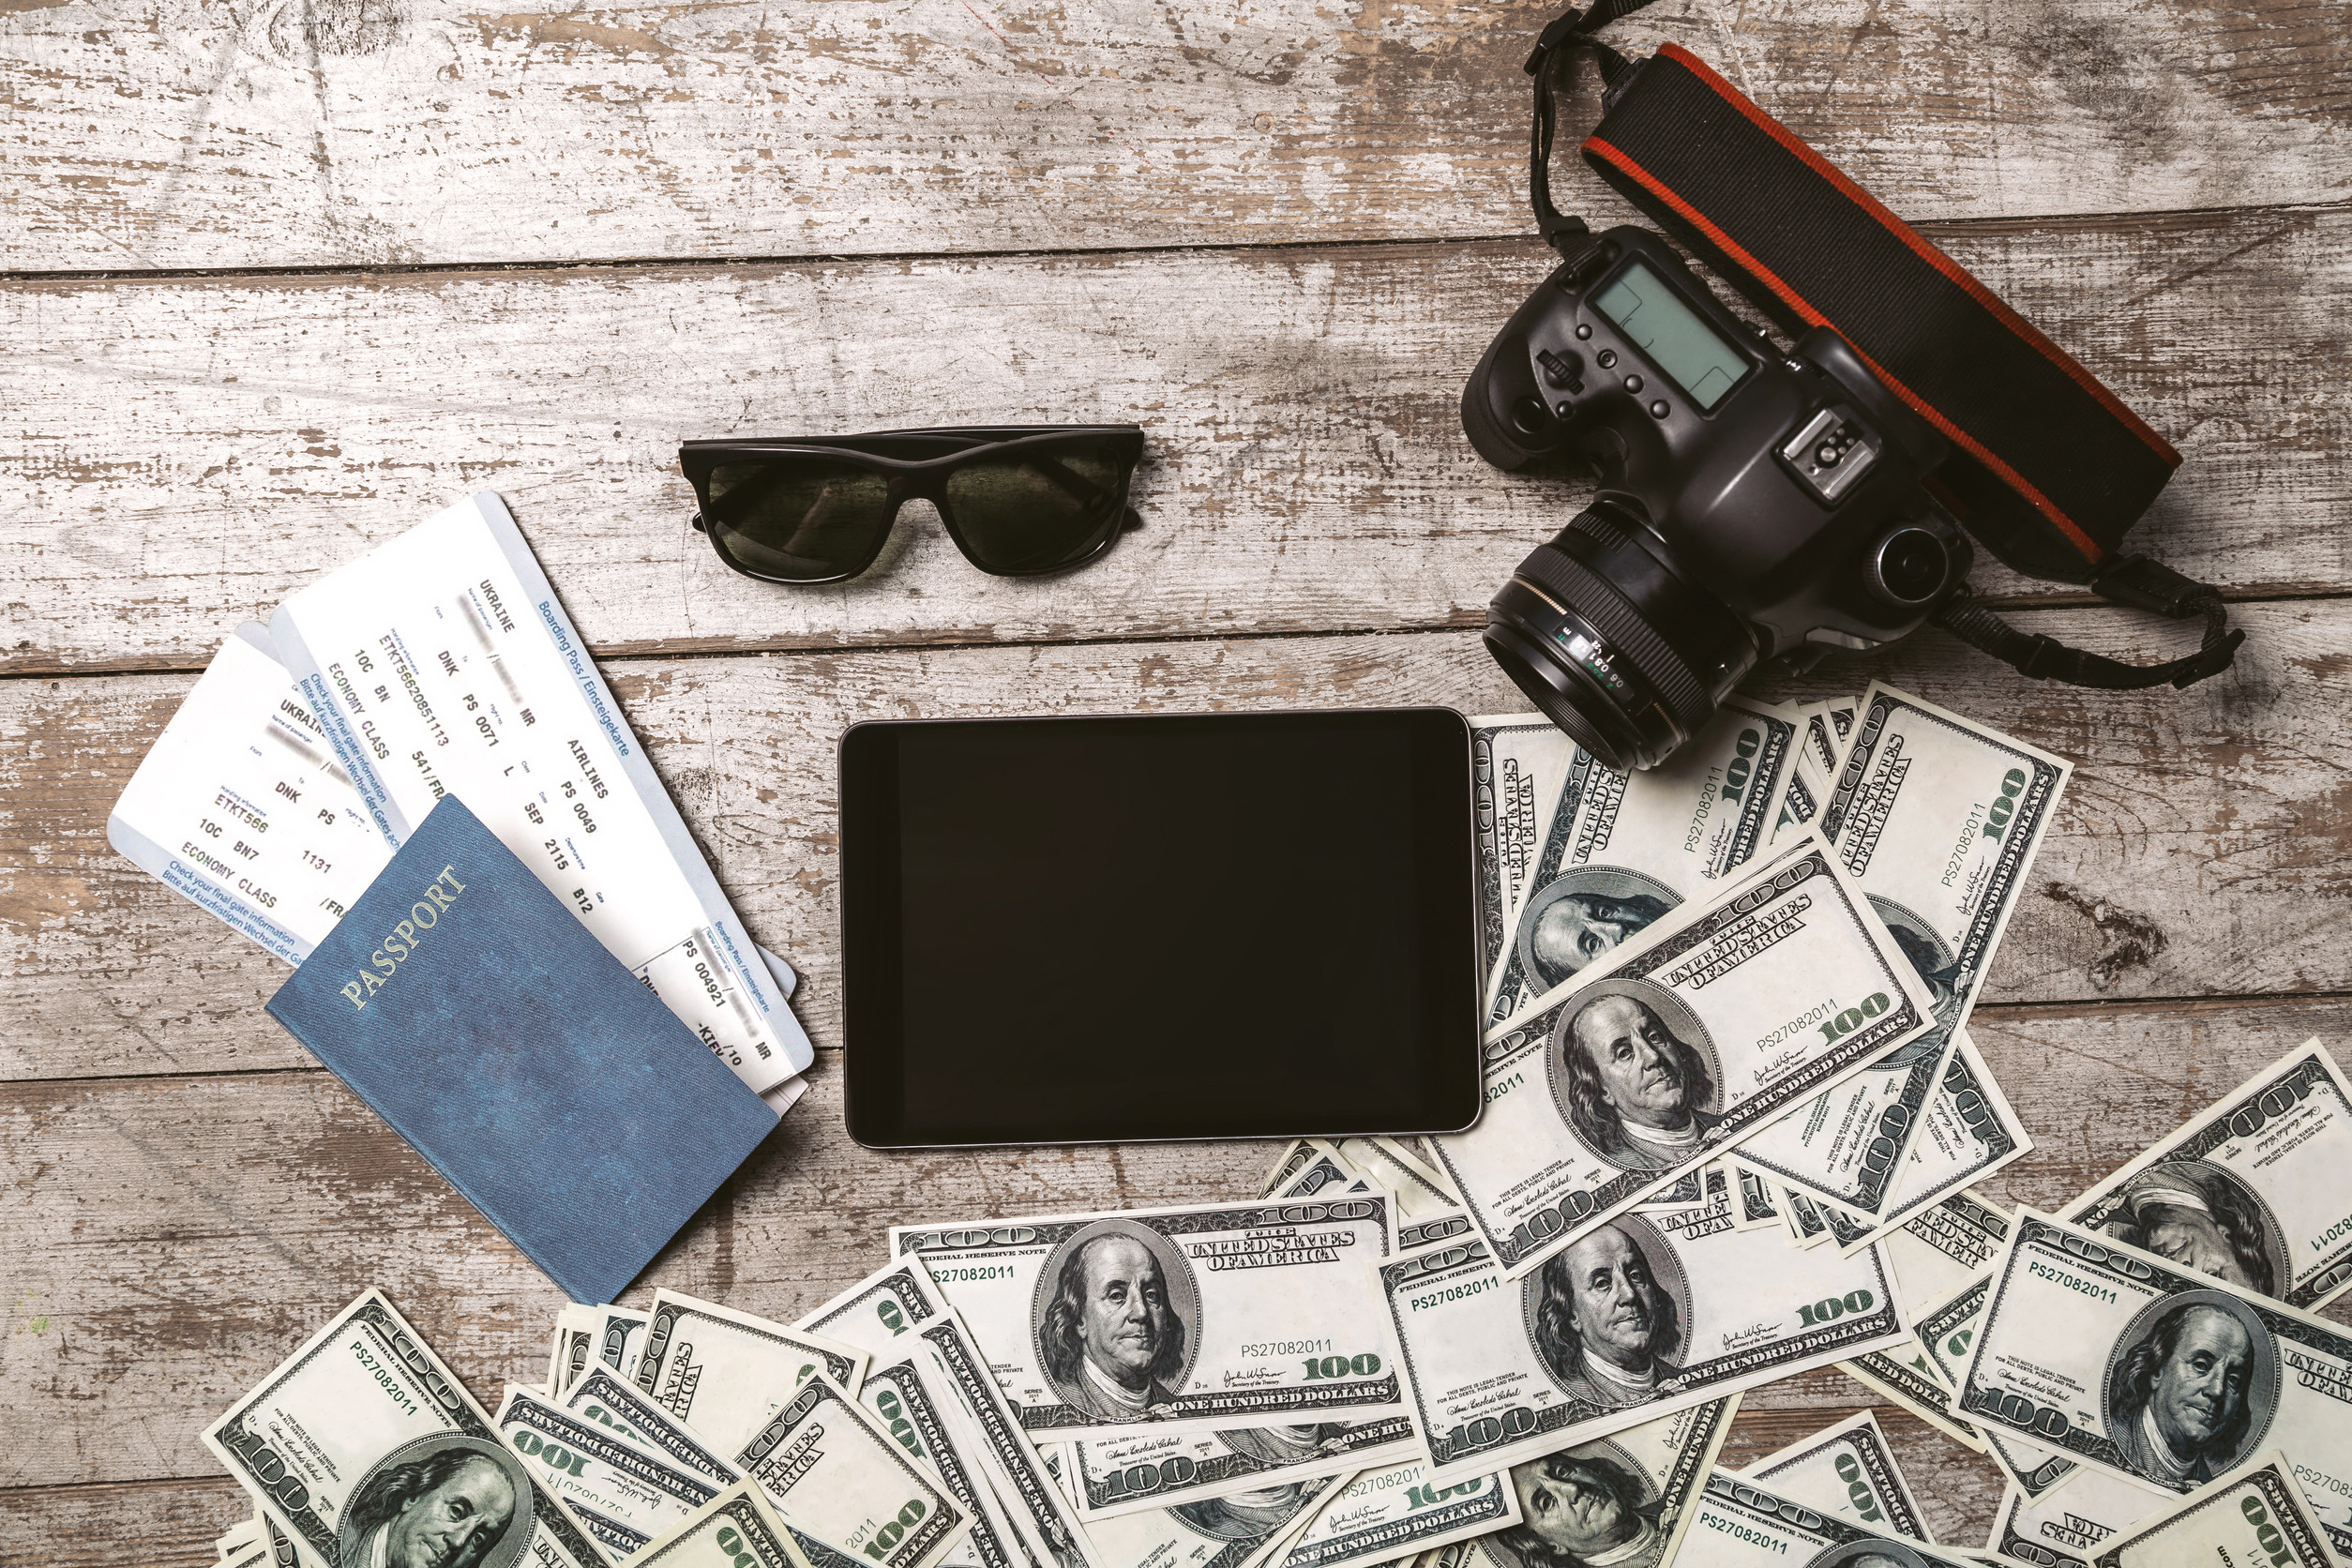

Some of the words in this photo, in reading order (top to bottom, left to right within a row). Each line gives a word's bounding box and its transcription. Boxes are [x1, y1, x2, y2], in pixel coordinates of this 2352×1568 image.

[355, 649, 373, 673] 10C
[374, 686, 391, 703] BN
[379, 635, 449, 746] ETKT56620851113
[480, 580, 515, 633] UKRAINE
[567, 740, 609, 799] AIRLINES
[538, 600, 570, 652] Boarding
[566, 650, 584, 676] Pass
[583, 680, 630, 757] Einsteigekarte
[310, 673, 328, 701] Check
[323, 699, 339, 718] your
[336, 716, 349, 737] final
[344, 735, 360, 756] gate
[356, 754, 387, 803] information
[328, 663, 365, 715] ECONOMY
[361, 720, 389, 760] CLASS
[520, 708, 535, 727] MR
[300, 679, 315, 700] Bitte
[310, 698, 323, 714] auf
[320, 712, 350, 763] kurzfristigen
[347, 761, 368, 796] Wechsel
[366, 795, 378, 810] der
[374, 809, 391, 838] Gates
[438, 650, 460, 677] DNK
[462, 694, 478, 711] PS
[475, 716, 499, 747] 0071
[504, 766, 514, 776] L
[561, 781, 577, 798] PS
[573, 803, 596, 834] 0049
[1723, 728, 1761, 807] 100
[215, 794, 269, 834] ETKT566
[275, 781, 302, 804] DNK
[317, 808, 336, 825] PS
[524, 803, 544, 825] SEP
[1685, 766, 1724, 853] PS27082011
[1983, 768, 2026, 845] 100
[199, 819, 222, 838] 10C
[234, 841, 259, 861] BN7
[302, 850, 332, 874] 1131
[545, 839, 569, 870] 2115
[1941, 803, 1985, 888] PS27082011
[1975, 851, 2017, 941] HUNDRED
[2013, 774, 2049, 852] DOLLARS
[181, 841, 235, 880] ECONOMY
[238, 879, 278, 908] CLASS
[573, 888, 593, 914] B12
[1712, 860, 1814, 929] 100
[162, 869, 182, 887] Bitte
[180, 883, 196, 896] auf
[194, 892, 243, 929] kurzfristigen
[243, 922, 276, 952] Wechsel
[275, 945, 290, 957] der
[170, 860, 194, 882] Check
[193, 876, 212, 893] your
[212, 886, 232, 905] final
[229, 900, 249, 917] gate
[248, 912, 295, 946] information
[339, 864, 466, 1011] PASSPORT
[715, 921, 734, 951] Boarding
[731, 949, 743, 967] Pass
[741, 967, 770, 1013] Einsteigekarte
[683, 940, 699, 957] PS
[694, 962, 726, 1007] 004921
[755, 1041, 773, 1061] MR
[1756, 998, 1839, 1052] PS27082011
[1817, 991, 1891, 1047] 100
[1517, 1042, 1543, 1062] NOTE
[1721, 1103, 1758, 1130] ONE
[1755, 1062, 1834, 1111] HUNDRED
[1831, 1015, 1909, 1071] DOLLARS
[2229, 1070, 2314, 1138] 100
[1492, 1200, 1502, 1209] FOR
[1529, 1176, 1545, 1190] PUBLIC
[1545, 1169, 1556, 1179] AND
[1555, 1158, 1575, 1173] PRIVATE
[1511, 1184, 1523, 1193] NOTE
[1529, 1171, 1544, 1184] LEGAL
[1543, 1160, 1562, 1174] TENDER
[1671, 1149, 1701, 1168] FRANKLIN
[916, 1227, 1037, 1249] 100
[1257, 1200, 1374, 1226] 100
[1509, 1190, 1595, 1253] 100
[965, 1250, 1017, 1259] RESERVE
[2028, 1244, 2075, 1267] FEDERAL
[2074, 1261, 2127, 1286] RESERVE
[2126, 1281, 2155, 1297] NOTE
[2041, 1228, 2152, 1279] 100
[1398, 1274, 1447, 1293] FEDERAL
[1410, 1275, 1500, 1312] PS27082011
[1795, 1289, 1874, 1330] 100
[2028, 1261, 2118, 1305] PS27082011
[374, 1316, 460, 1410] 100
[1241, 1338, 1332, 1357] PS27082011
[1302, 1353, 1381, 1380] 100
[1677, 1366, 1712, 1385] ONE
[1714, 1343, 1805, 1373] HUNDRED
[1804, 1317, 1887, 1347] DOLLARS
[349, 1340, 418, 1417] PS27082011
[359, 1322, 396, 1367] FEDERAL
[394, 1362, 430, 1405] RESERVE
[430, 1401, 452, 1428] NOTE
[1172, 1399, 1209, 1411] ONE
[1208, 1393, 1304, 1410] HUNDRED
[1304, 1385, 1389, 1403] DOLLARS
[1621, 1395, 1652, 1407] FRANKLIN
[1445, 1406, 1538, 1454] 100
[1984, 1386, 2071, 1438] 100
[234, 1429, 309, 1512] 100
[513, 1430, 593, 1479] 100
[1103, 1455, 1198, 1499] 100
[1282, 1454, 1317, 1464] FRANKLIN
[2144, 1471, 2177, 1487] FRANKLIN
[1707, 1476, 1823, 1530] 100
[1834, 1453, 1885, 1523] 100
[1699, 1512, 1787, 1555] PS27082011
[1746, 1513, 1798, 1536] RESERVE
[1797, 1530, 1826, 1547] NOTE
